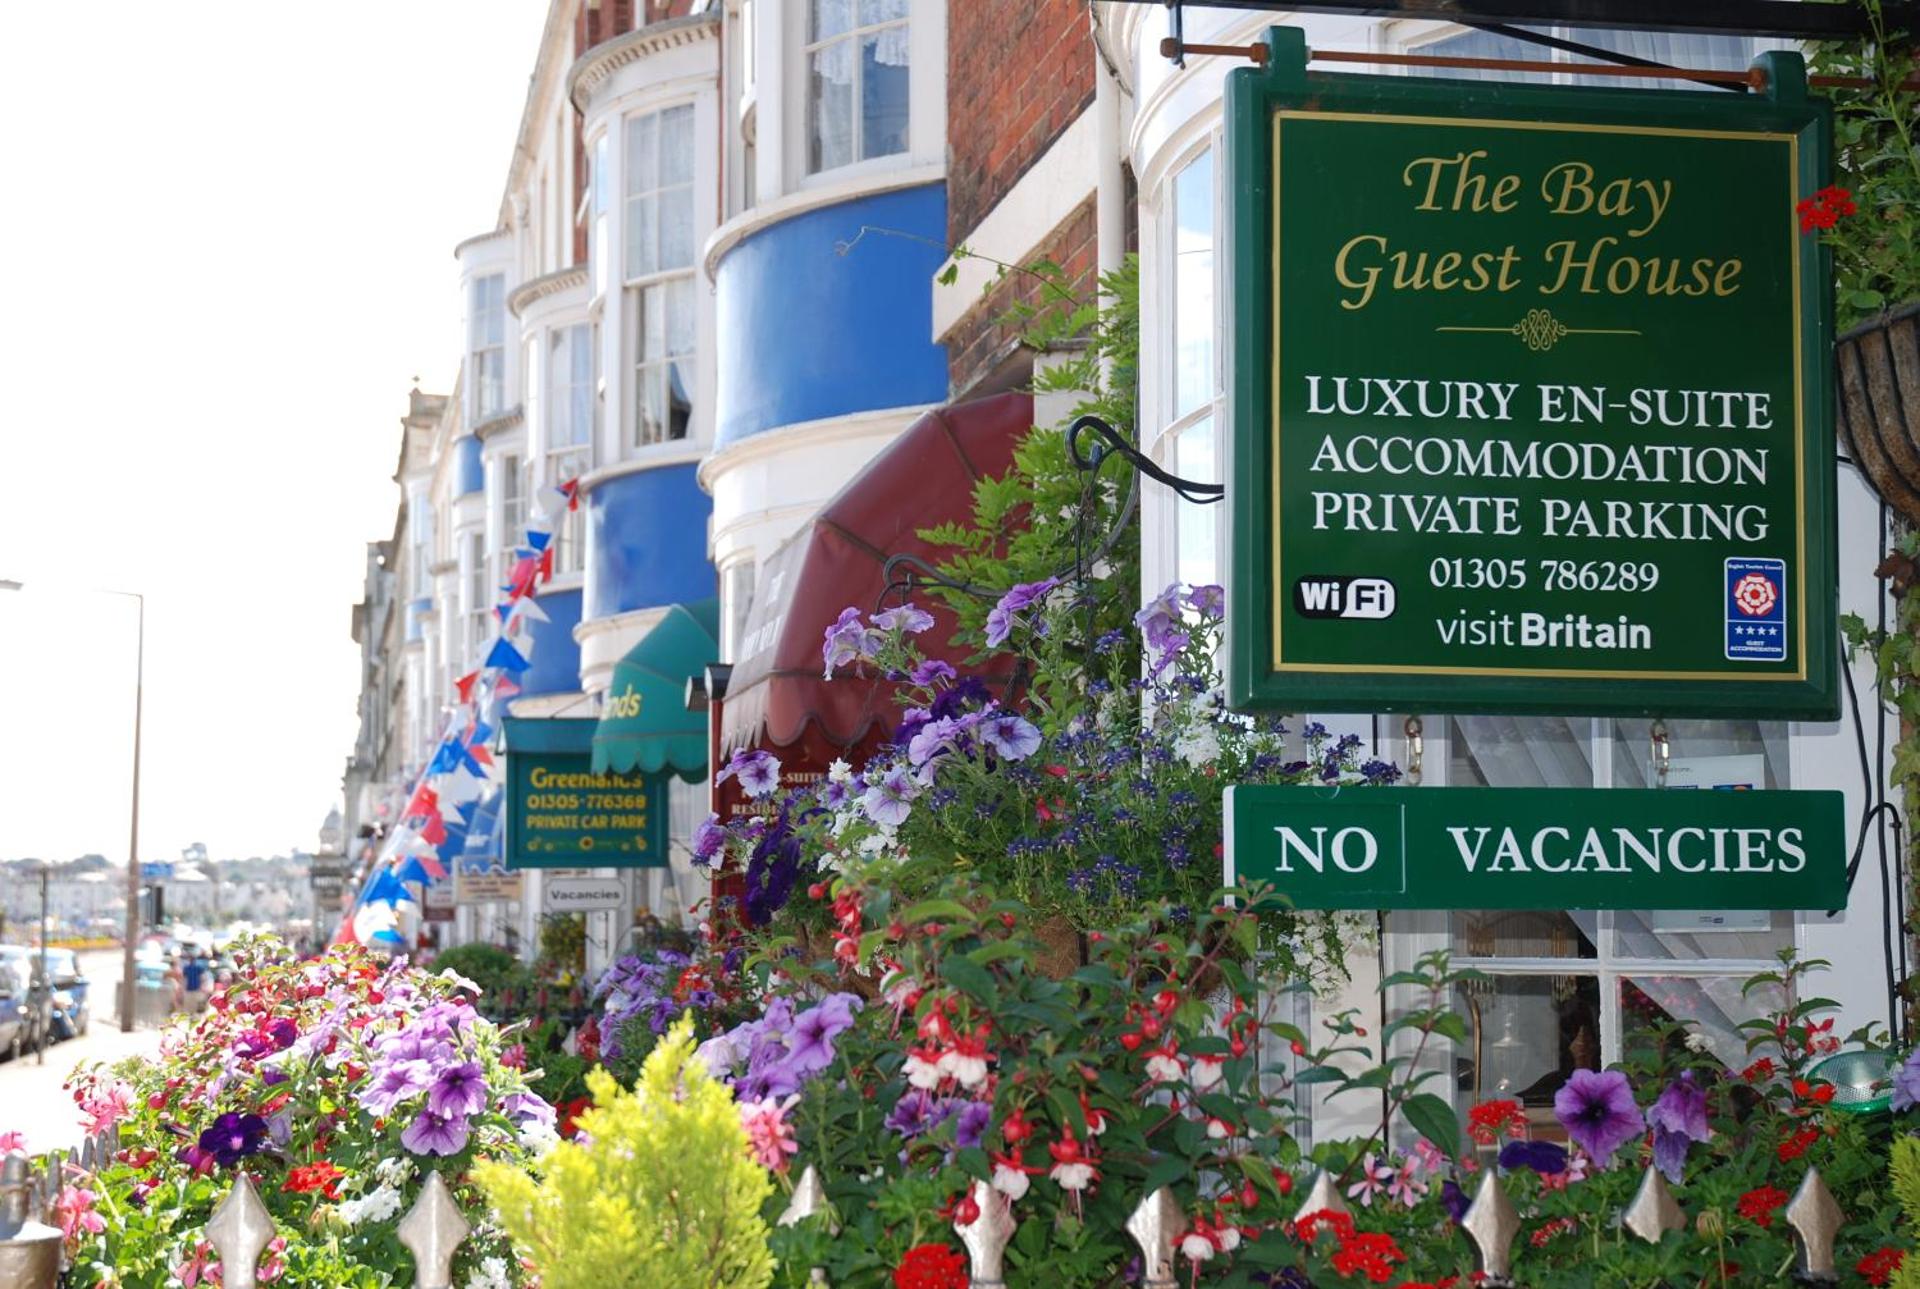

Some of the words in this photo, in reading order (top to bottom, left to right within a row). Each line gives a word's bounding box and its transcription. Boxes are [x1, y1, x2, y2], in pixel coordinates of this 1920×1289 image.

[1403, 150, 1521, 213] The
[1541, 162, 1671, 238] Bay
[1334, 235, 1521, 310] Guest
[1539, 236, 1742, 296] House
[1306, 375, 1519, 420] LUXURY
[1537, 384, 1774, 430] EN-SUITE
[1309, 434, 1769, 485] ACCOMMODATION
[1311, 491, 1522, 535] PRIVATE
[1541, 498, 1769, 542] PARKING
[1429, 557, 1527, 589] 01305
[1540, 560, 1659, 592] 786289
[526, 814, 579, 829] PRIVATE
[581, 814, 609, 829] CAR
[611, 814, 646, 829] PARK
[1274, 826, 1378, 873] NO
[1446, 826, 1806, 873] VACANCIES
[551, 887, 621, 900] Vacancies
